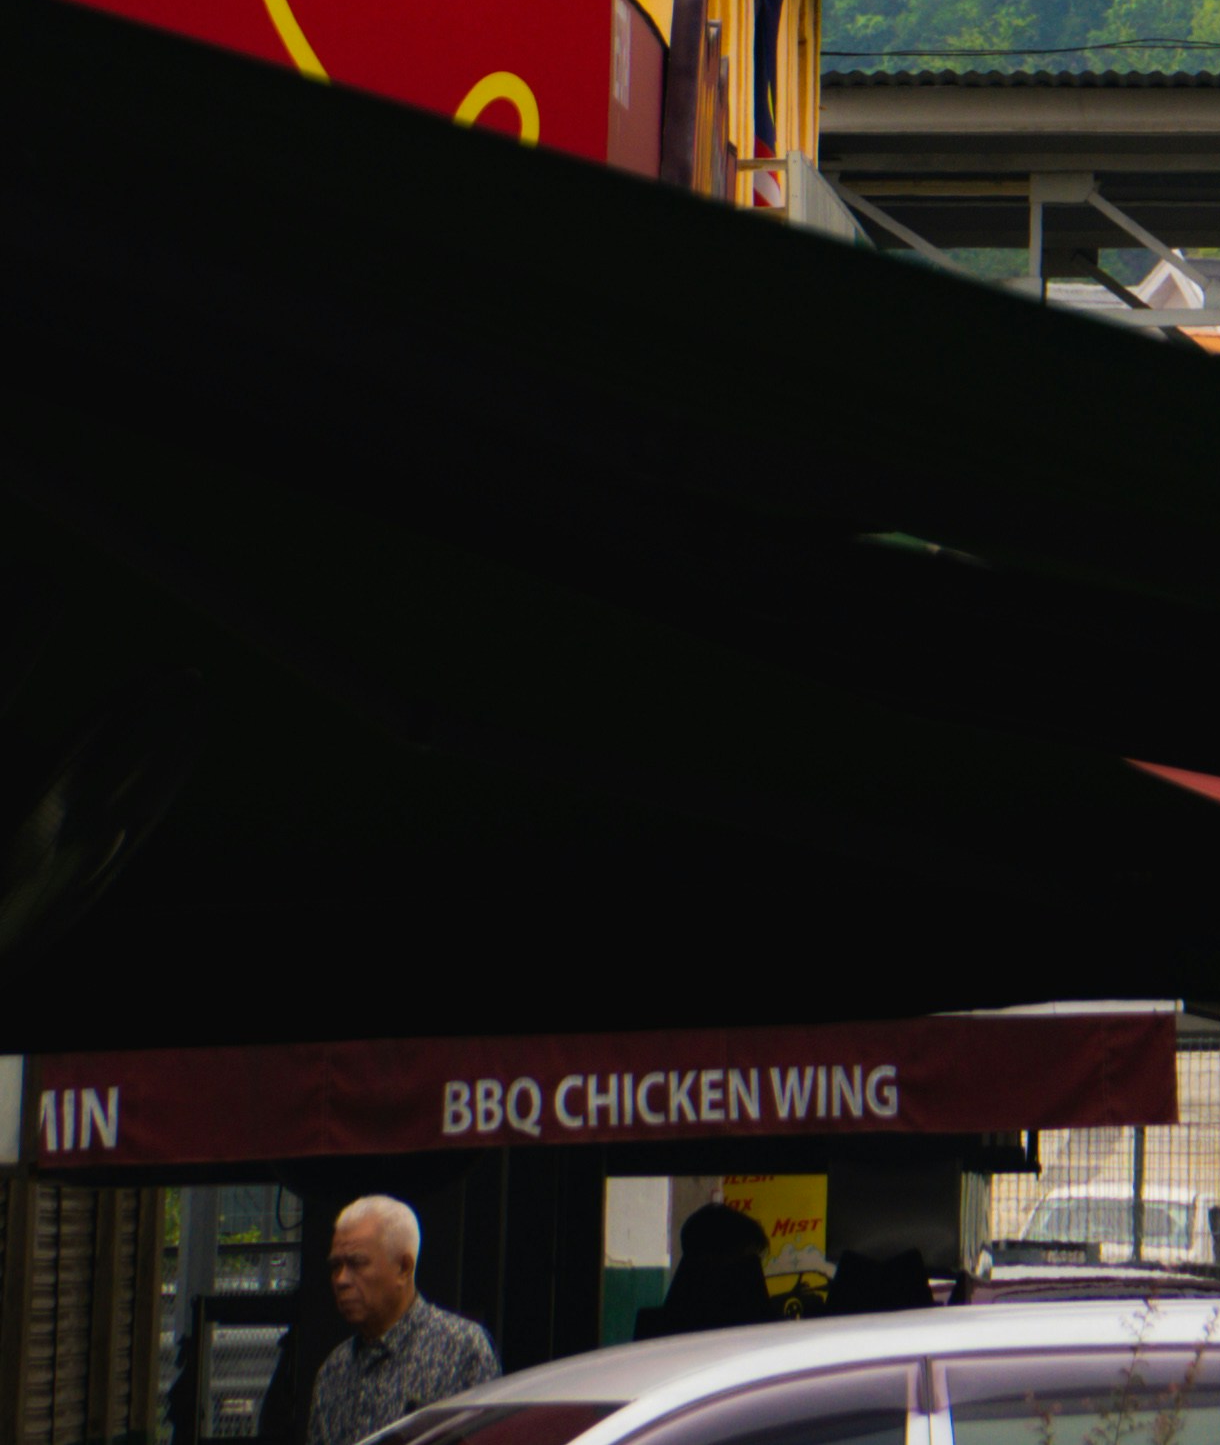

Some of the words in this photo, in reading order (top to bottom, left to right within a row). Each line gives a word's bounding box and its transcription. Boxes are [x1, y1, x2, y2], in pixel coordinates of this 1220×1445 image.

[442, 1077, 542, 1138] BBQ
[554, 1067, 761, 1129] CHICKEN
[769, 1064, 899, 1120] WING
